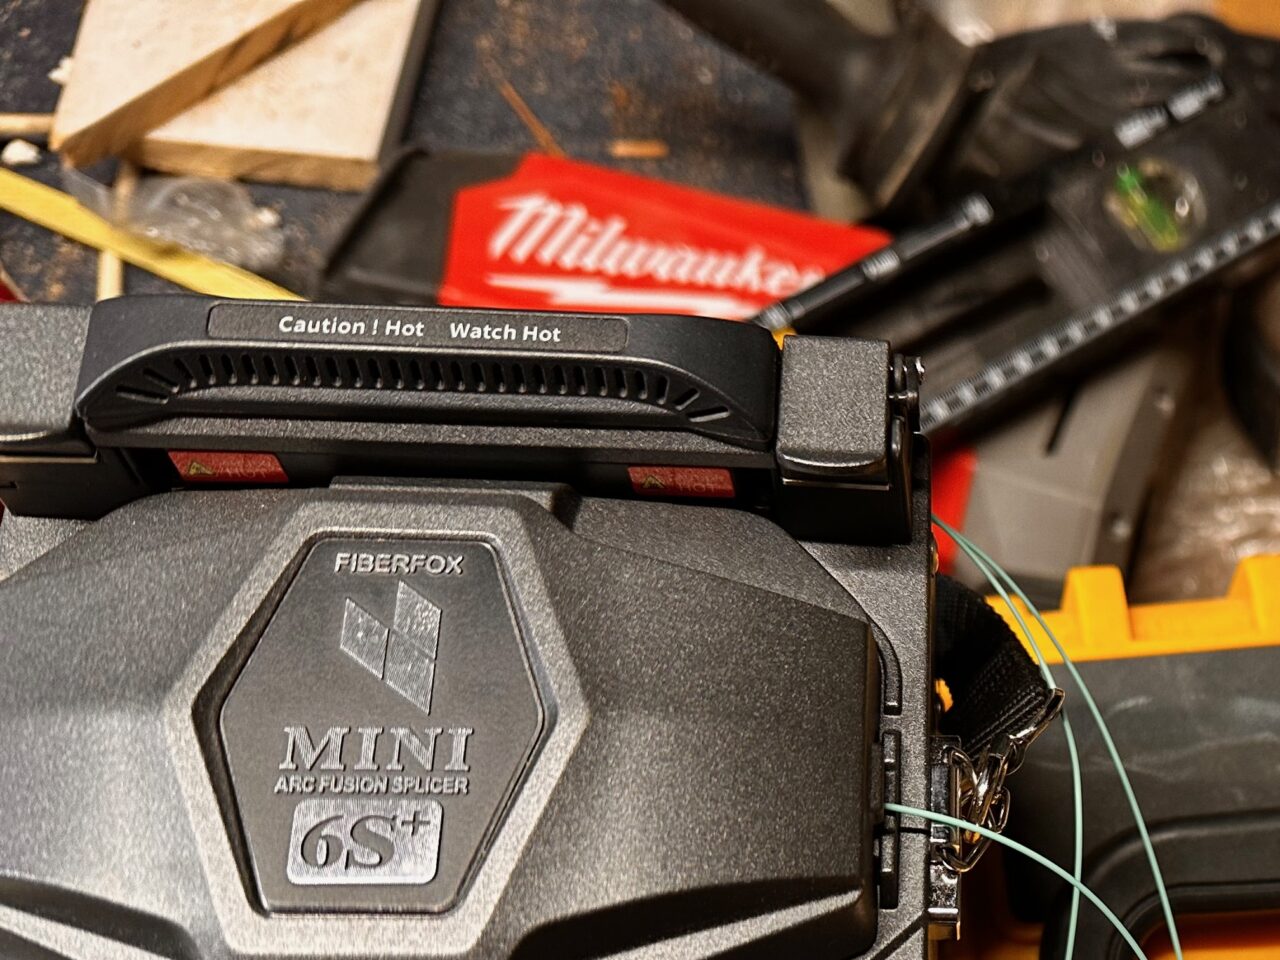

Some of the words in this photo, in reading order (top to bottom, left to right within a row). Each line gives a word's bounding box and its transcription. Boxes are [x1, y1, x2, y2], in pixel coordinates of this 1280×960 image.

[278, 315, 365, 336] Caution
[385, 319, 424, 337] Hot
[449, 322, 516, 341] Watch
[522, 325, 561, 343] Hot
[334, 552, 464, 575] FIBERFOX
[279, 726, 474, 772] MINI
[273, 775, 316, 794] ARC
[318, 776, 388, 795] FUSION
[391, 776, 471, 795] SPLICER
